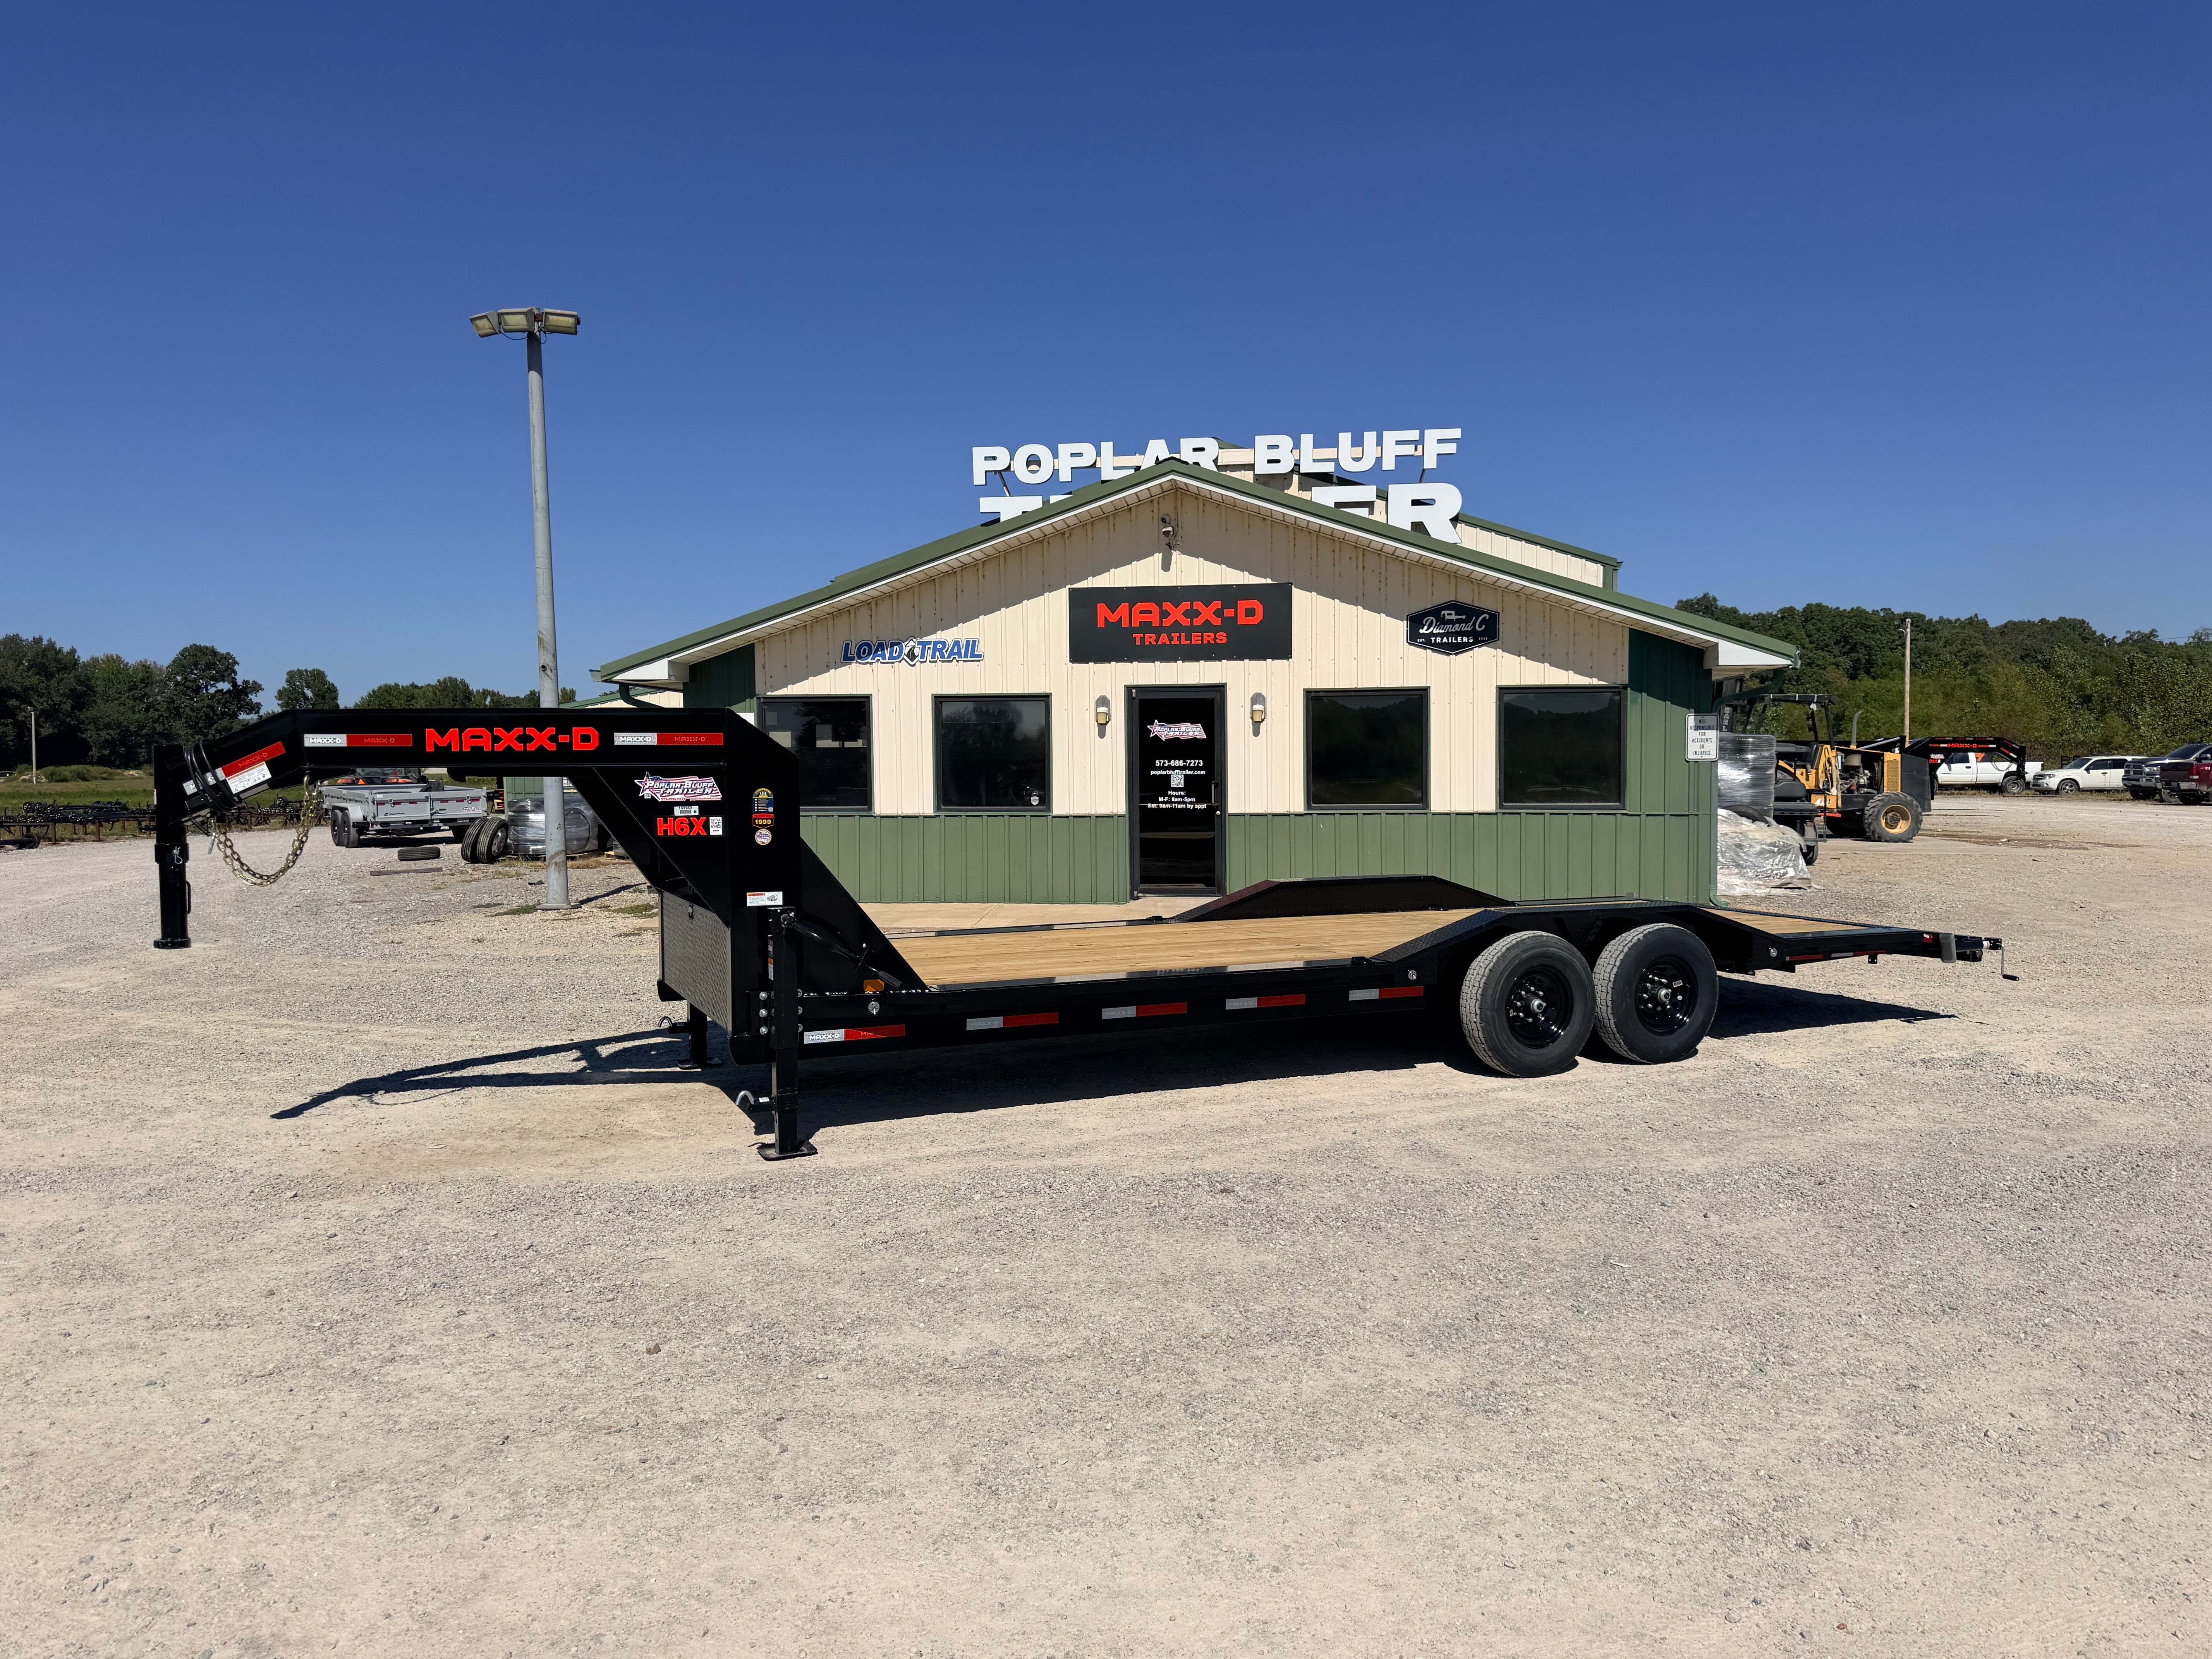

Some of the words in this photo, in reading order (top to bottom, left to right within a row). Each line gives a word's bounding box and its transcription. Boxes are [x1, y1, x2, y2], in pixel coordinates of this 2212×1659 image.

[972, 437, 1219, 485] POPLAR
[1254, 428, 1462, 474] BLUFF
[1097, 599, 1264, 628] MAXX-D
[1419, 616, 1475, 633] Diamond
[1475, 614, 1489, 631] C
[841, 640, 905, 663] LOAD
[916, 638, 984, 662] TRAIL
[1133, 632, 1228, 646] TRAILERS
[426, 727, 599, 751] MAXX-D
[657, 817, 707, 836] H6X
